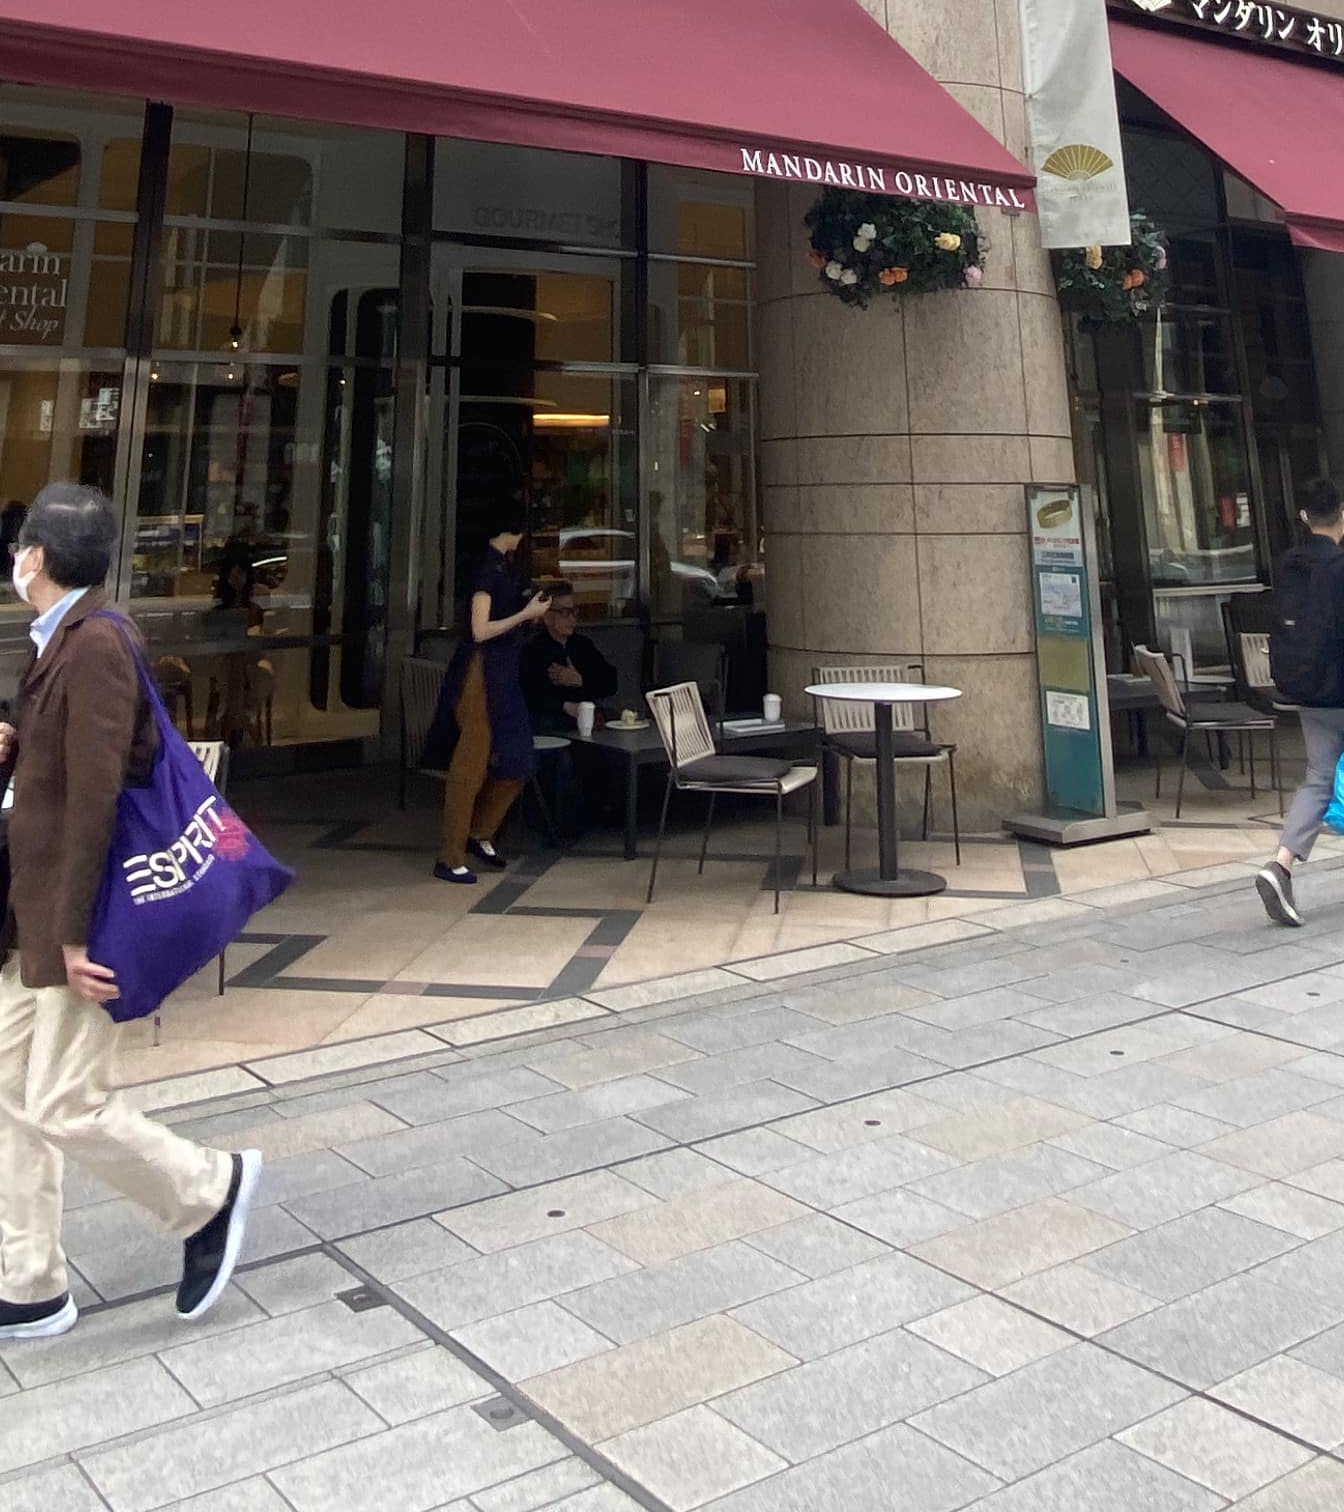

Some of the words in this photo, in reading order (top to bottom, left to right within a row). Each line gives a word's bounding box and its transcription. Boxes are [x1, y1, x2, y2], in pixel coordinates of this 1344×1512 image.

[740, 148, 886, 191] MANDARIN
[895, 172, 1026, 209] ORIENTAL
[9, 305, 59, 340] Shop
[123, 795, 225, 897] ESPRIT
